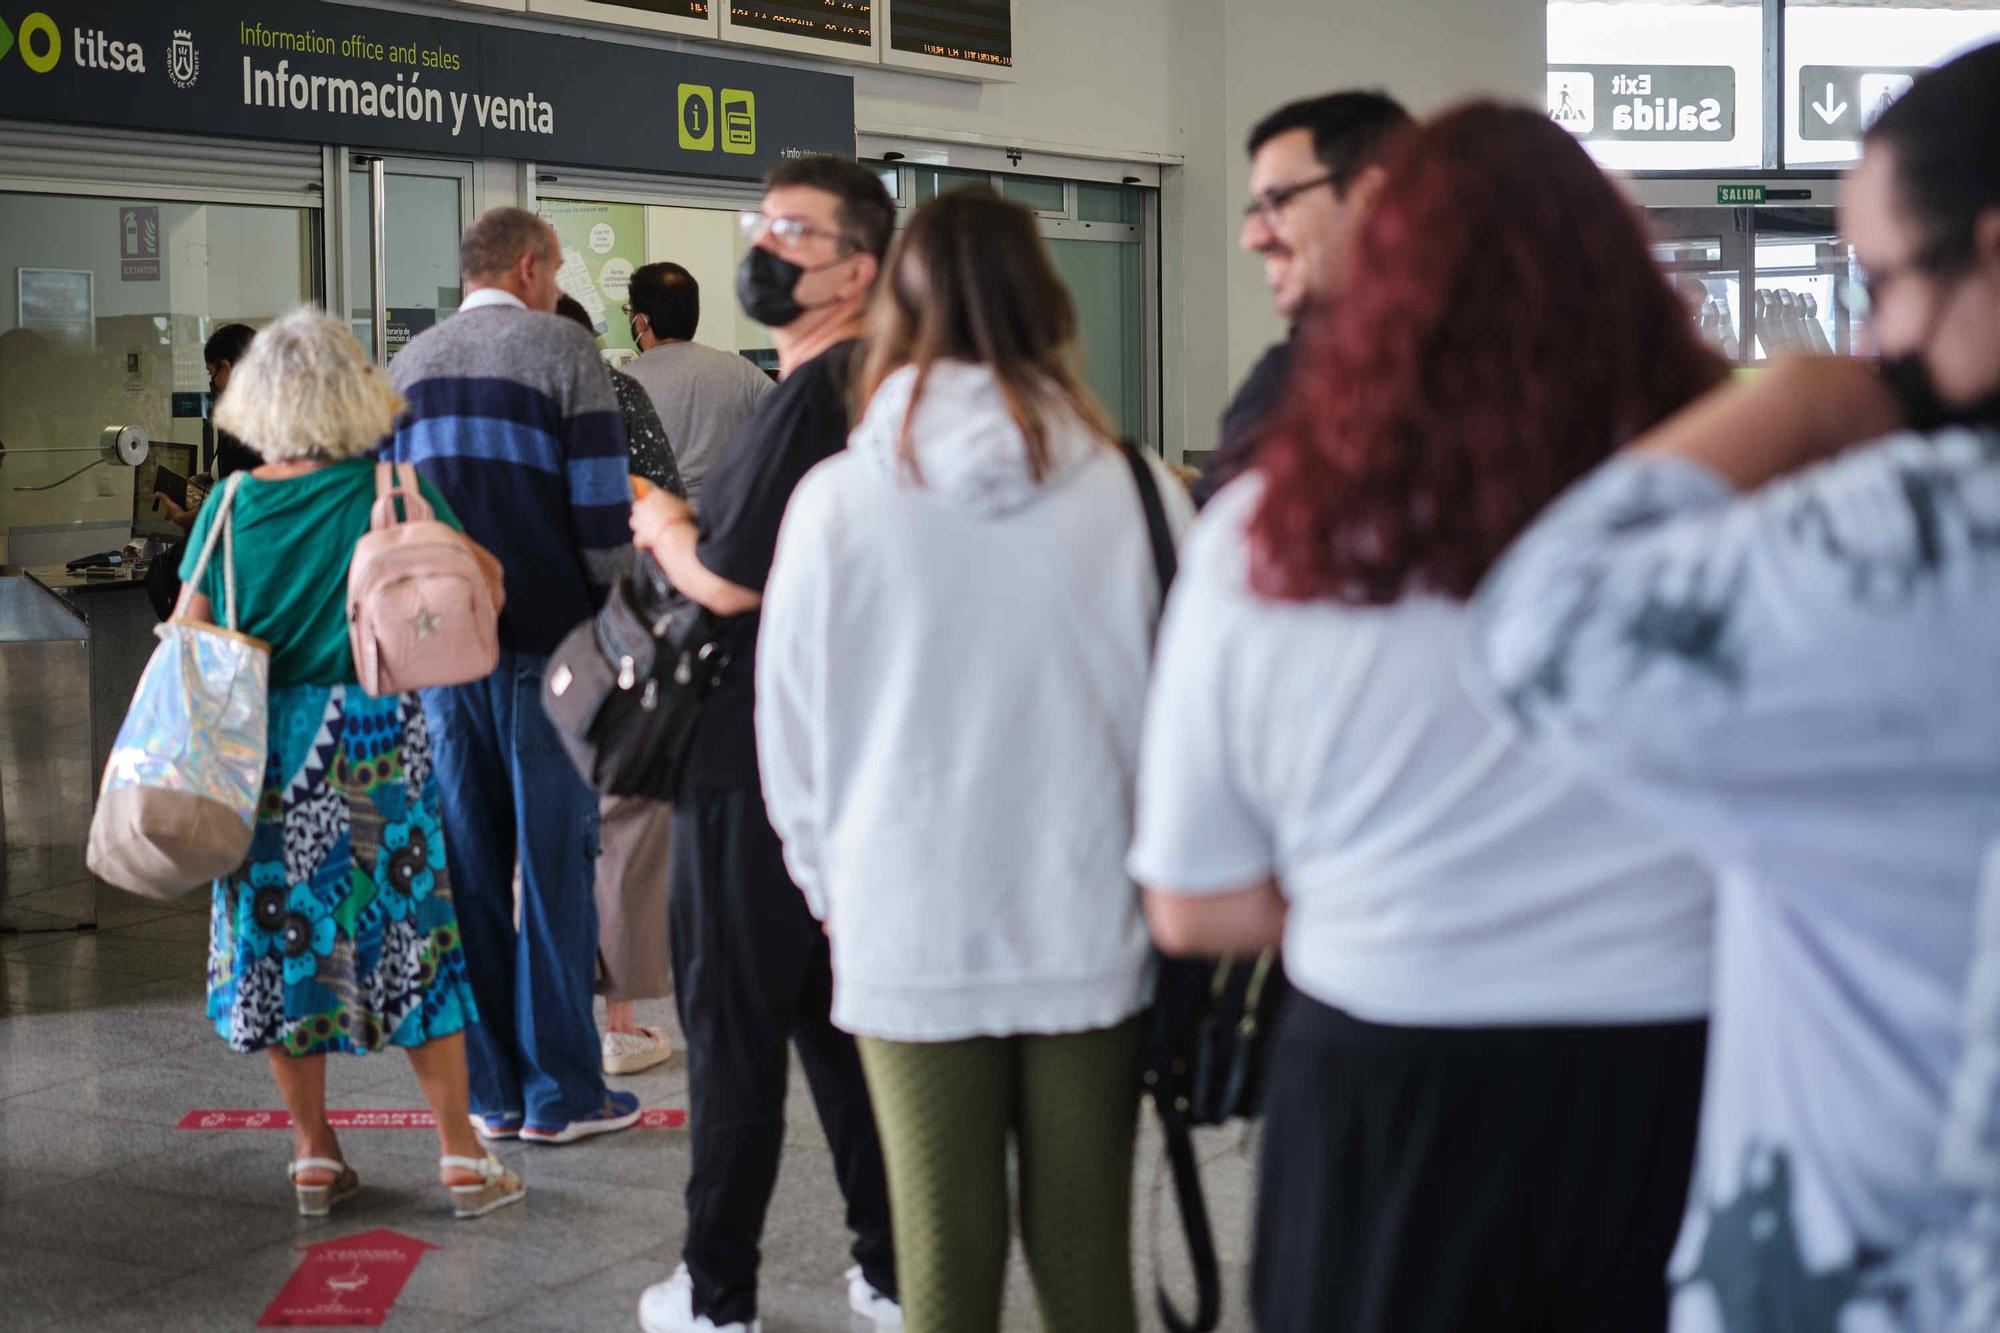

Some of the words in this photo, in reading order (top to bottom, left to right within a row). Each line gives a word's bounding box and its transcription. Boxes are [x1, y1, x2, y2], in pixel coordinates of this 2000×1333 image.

[74, 27, 146, 73] titsa
[240, 20, 336, 55] Information
[341, 34, 384, 61] office
[389, 41, 417, 65] and
[422, 46, 461, 71] sales
[243, 55, 443, 124] Información
[450, 90, 468, 136] y
[473, 91, 554, 134] venta
[1722, 188, 1762, 201] SALIDA
[123, 265, 159, 276] EXTINTOR
